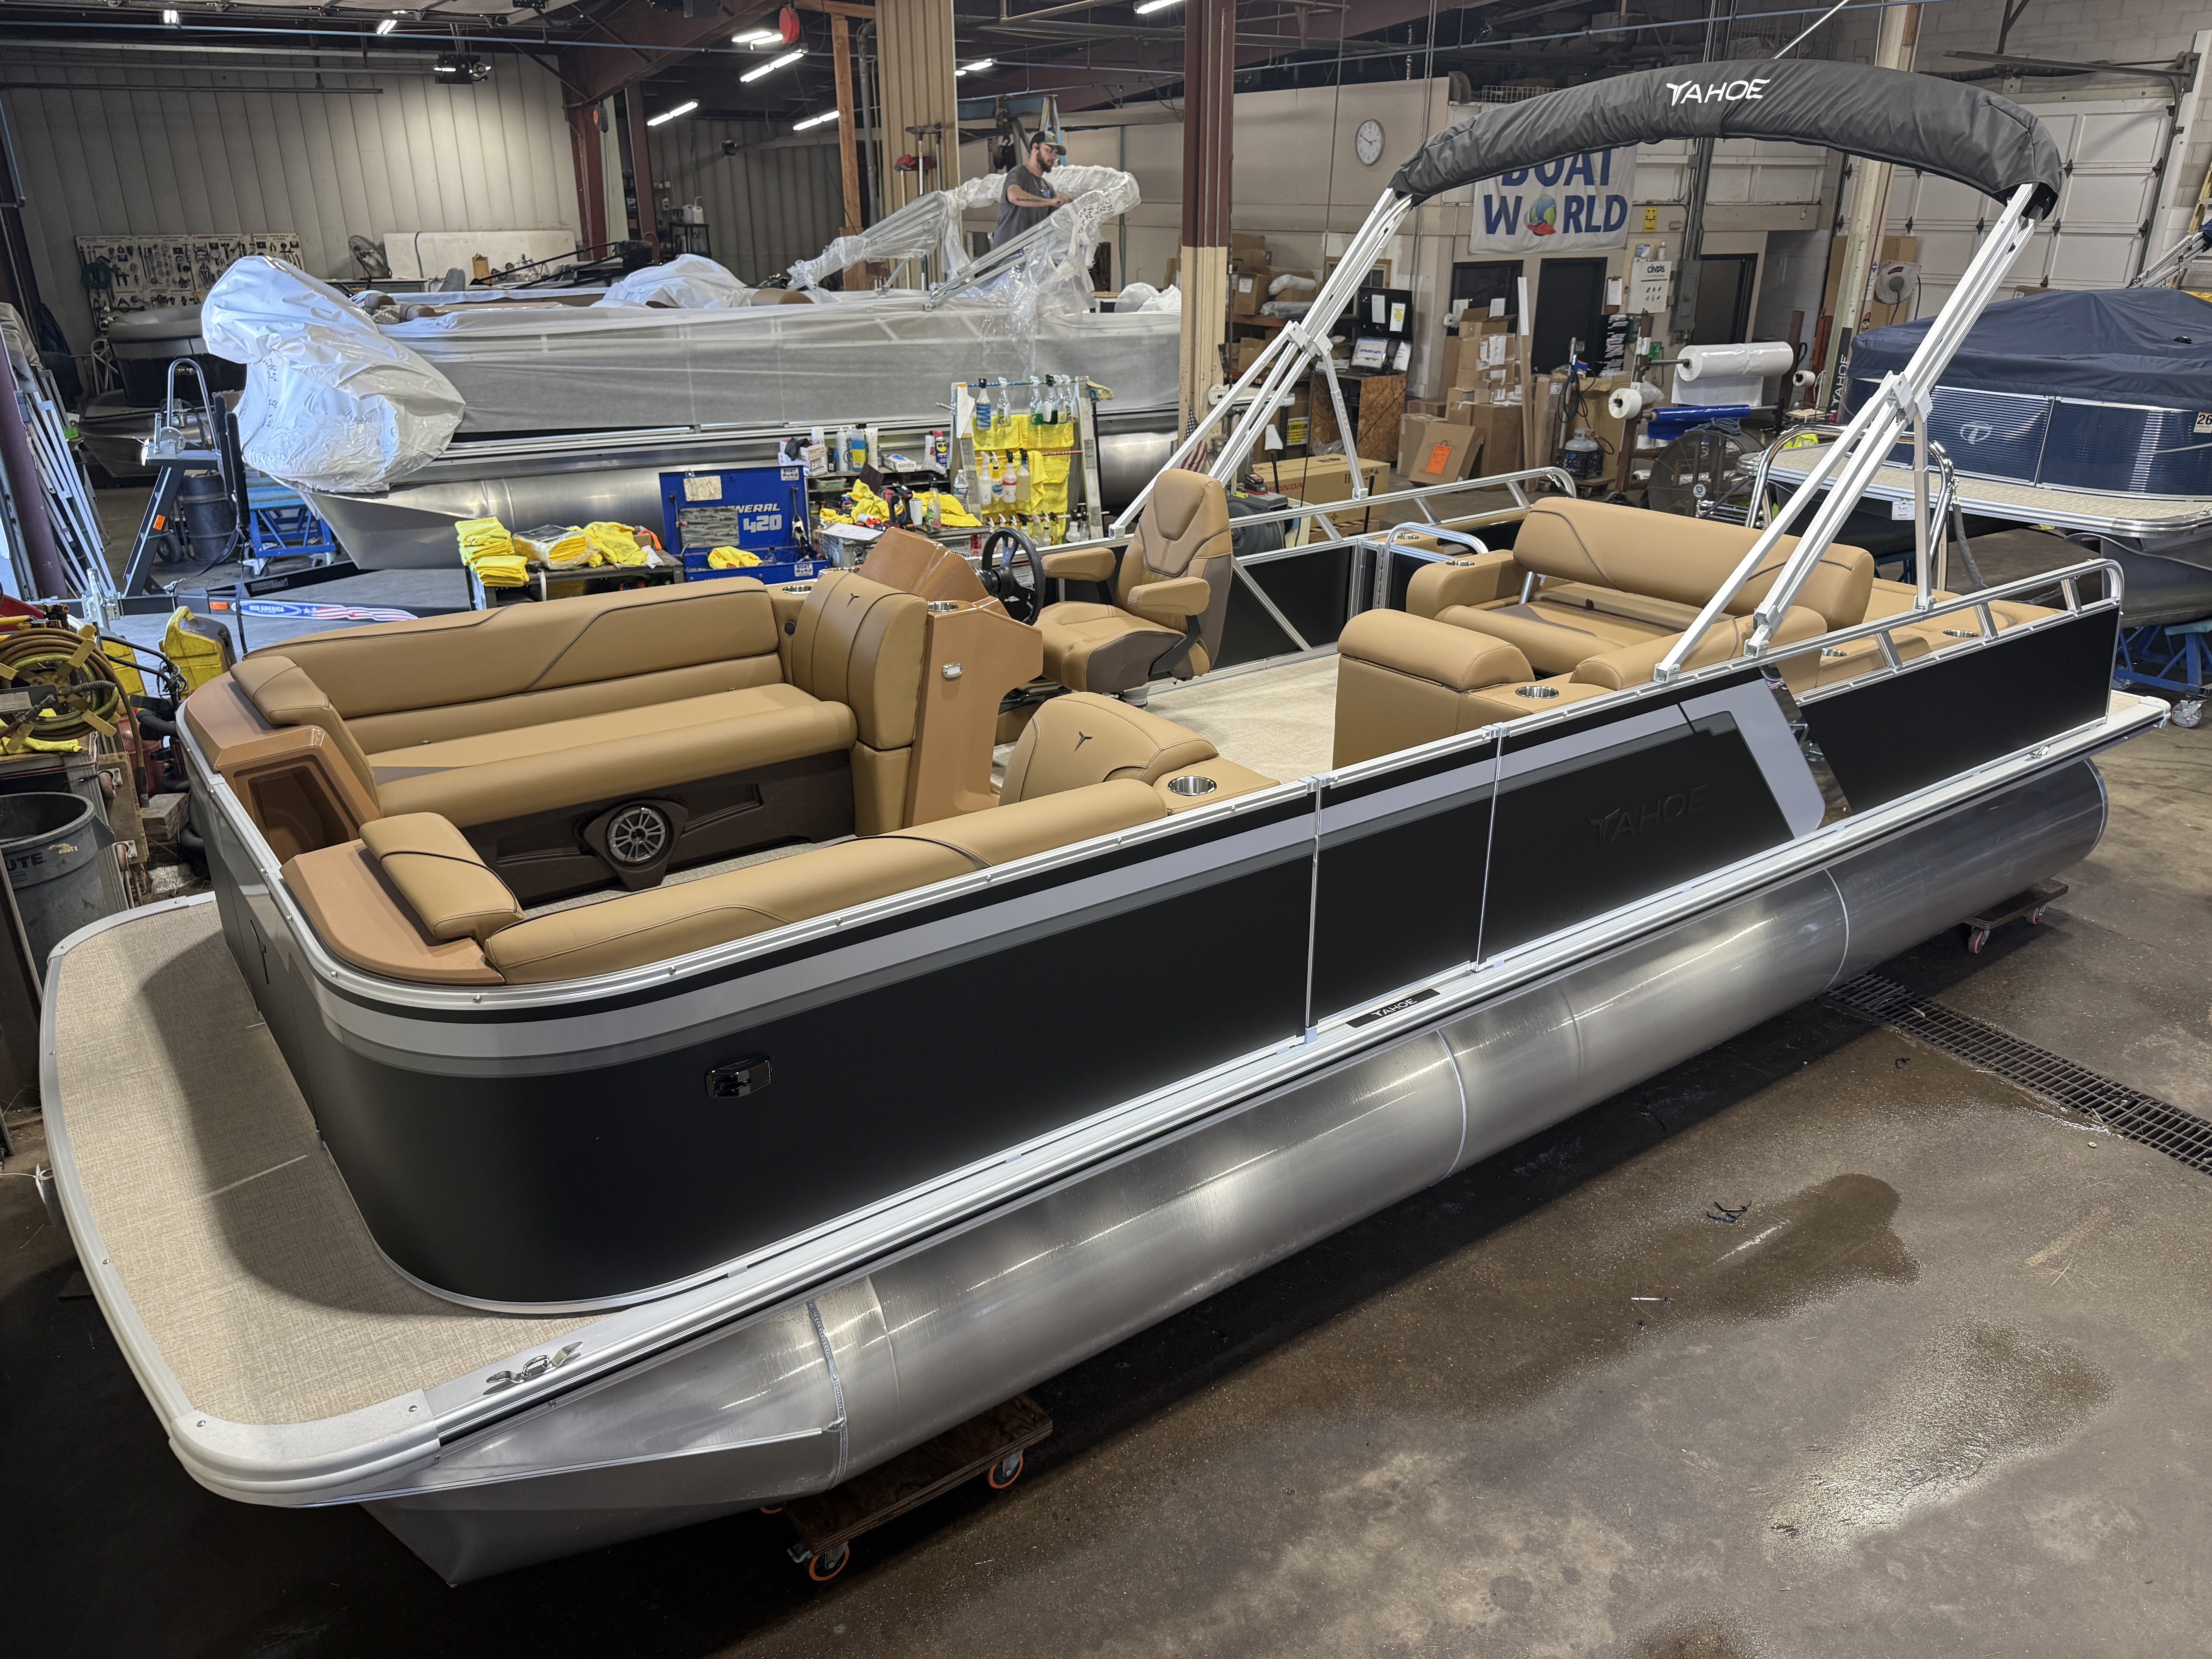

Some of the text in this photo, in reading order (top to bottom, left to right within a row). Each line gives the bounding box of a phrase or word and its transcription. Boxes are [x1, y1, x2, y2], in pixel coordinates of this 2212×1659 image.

[1666, 79, 1771, 106] TAHOE
[1831, 354, 1848, 407] TAHOE
[2197, 414, 2212, 425] 26
[1269, 483, 1303, 493] HONDA
[718, 503, 781, 514] NERAL
[743, 514, 782, 533] 420
[1589, 784, 1709, 848] TAHOE
[1371, 998, 1418, 1017] TAHOE
